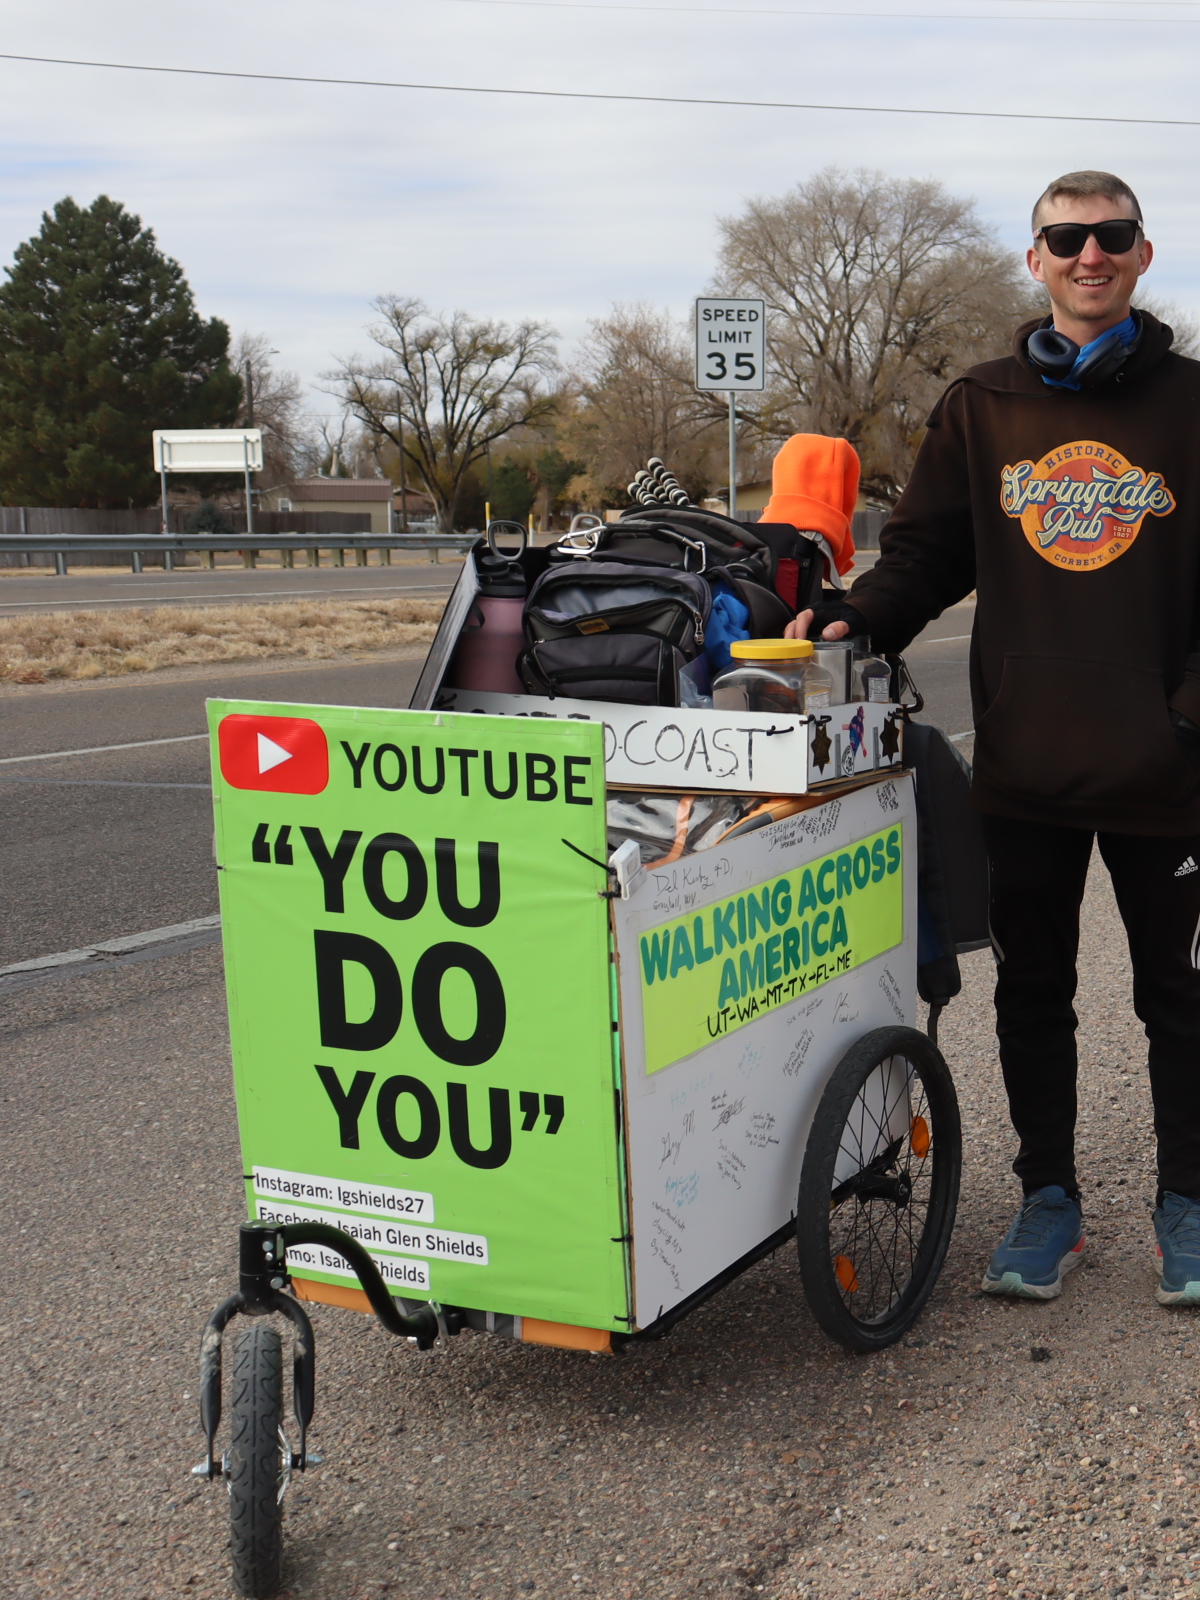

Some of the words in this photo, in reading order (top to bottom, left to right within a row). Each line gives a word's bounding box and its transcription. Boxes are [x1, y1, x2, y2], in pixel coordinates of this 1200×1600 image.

[702, 308, 759, 322] SPEED
[708, 330, 752, 343] LIMIT
[705, 352, 756, 380] 35
[1044, 445, 1123, 470] HISTORIC
[1002, 463, 1171, 514] Springdale
[1037, 504, 1141, 547] Pub
[1113, 525, 1131, 533] ESTD
[1053, 553, 1108, 566] CORBETT,
[1109, 542, 1123, 555] OR
[340, 740, 593, 806] YOUTUBE
[252, 823, 501, 928] “YOU
[1174, 865, 1199, 877] adidas
[640, 879, 792, 986] WALKING
[798, 830, 901, 917] ACROSS
[718, 905, 848, 1010] AMERICA
[313, 929, 506, 1067] DO
[314, 1064, 565, 1169] YOU”
[255, 1172, 333, 1200] Instagram:
[338, 1186, 424, 1214] Igshields27
[259, 1206, 332, 1227] Facebk
[338, 1219, 381, 1242] Isaiah
[386, 1229, 420, 1249] Glen
[426, 1234, 484, 1257] Shields
[320, 1251, 355, 1271] Isaia
